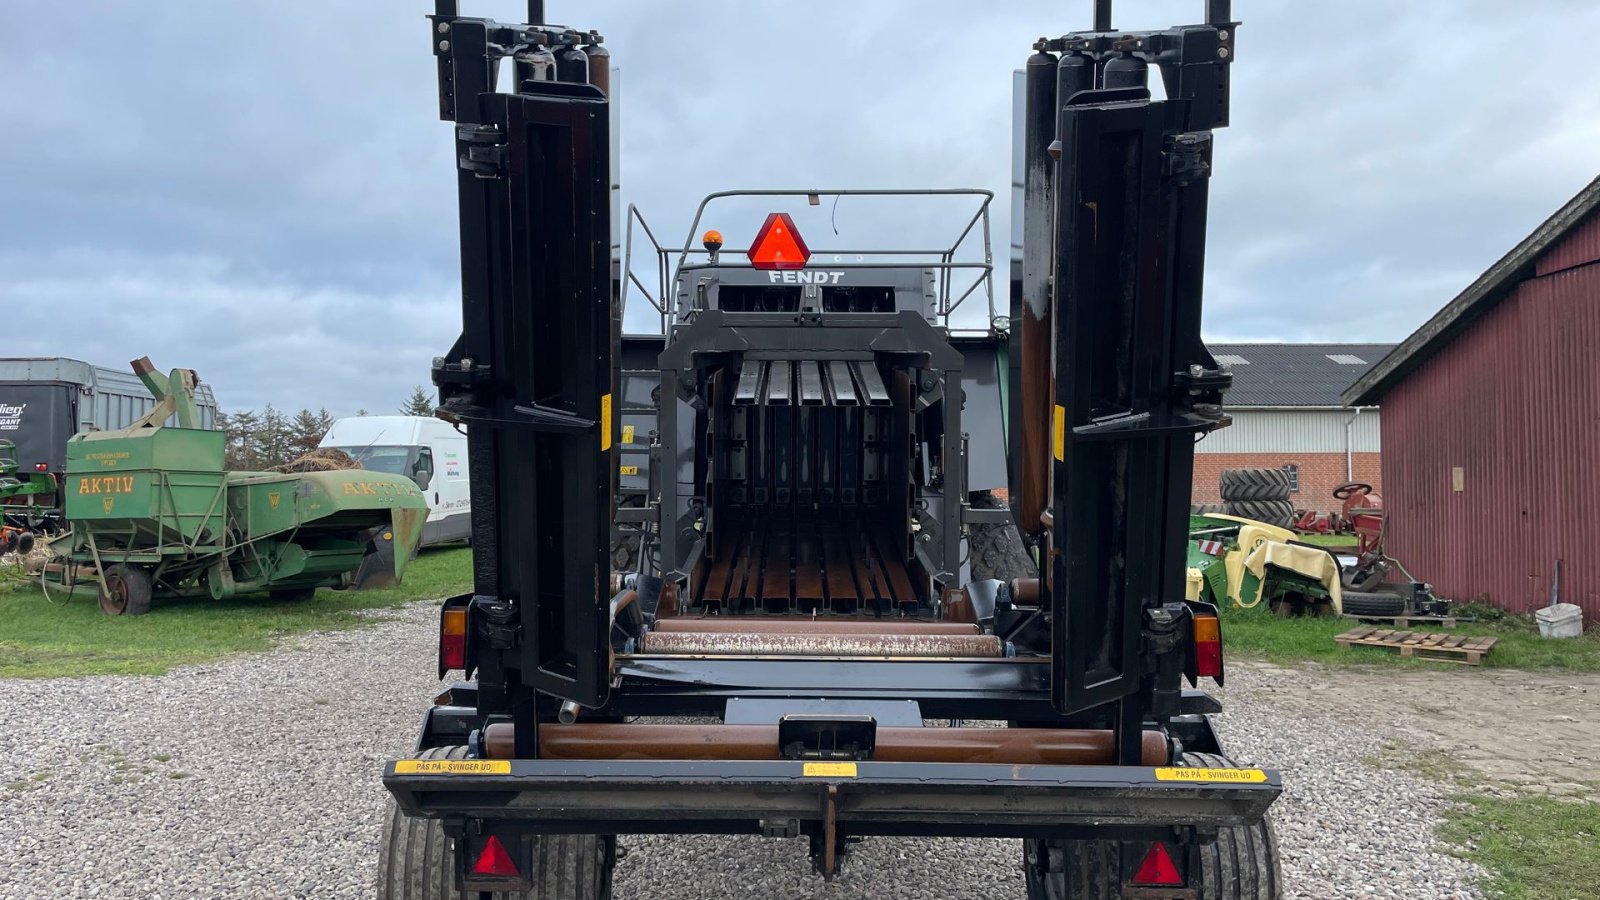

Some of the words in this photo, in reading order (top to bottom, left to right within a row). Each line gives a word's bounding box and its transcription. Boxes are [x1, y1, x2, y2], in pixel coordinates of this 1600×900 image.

[768, 270, 845, 284] FENDT
[79, 476, 134, 495] AKTIV
[416, 763, 430, 771] PAS
[447, 762, 479, 771] SVINGER
[480, 763, 491, 771] UD
[1175, 770, 1190, 778] PAS
[1207, 771, 1239, 779] SVINGER
[1240, 772, 1251, 780] UD
